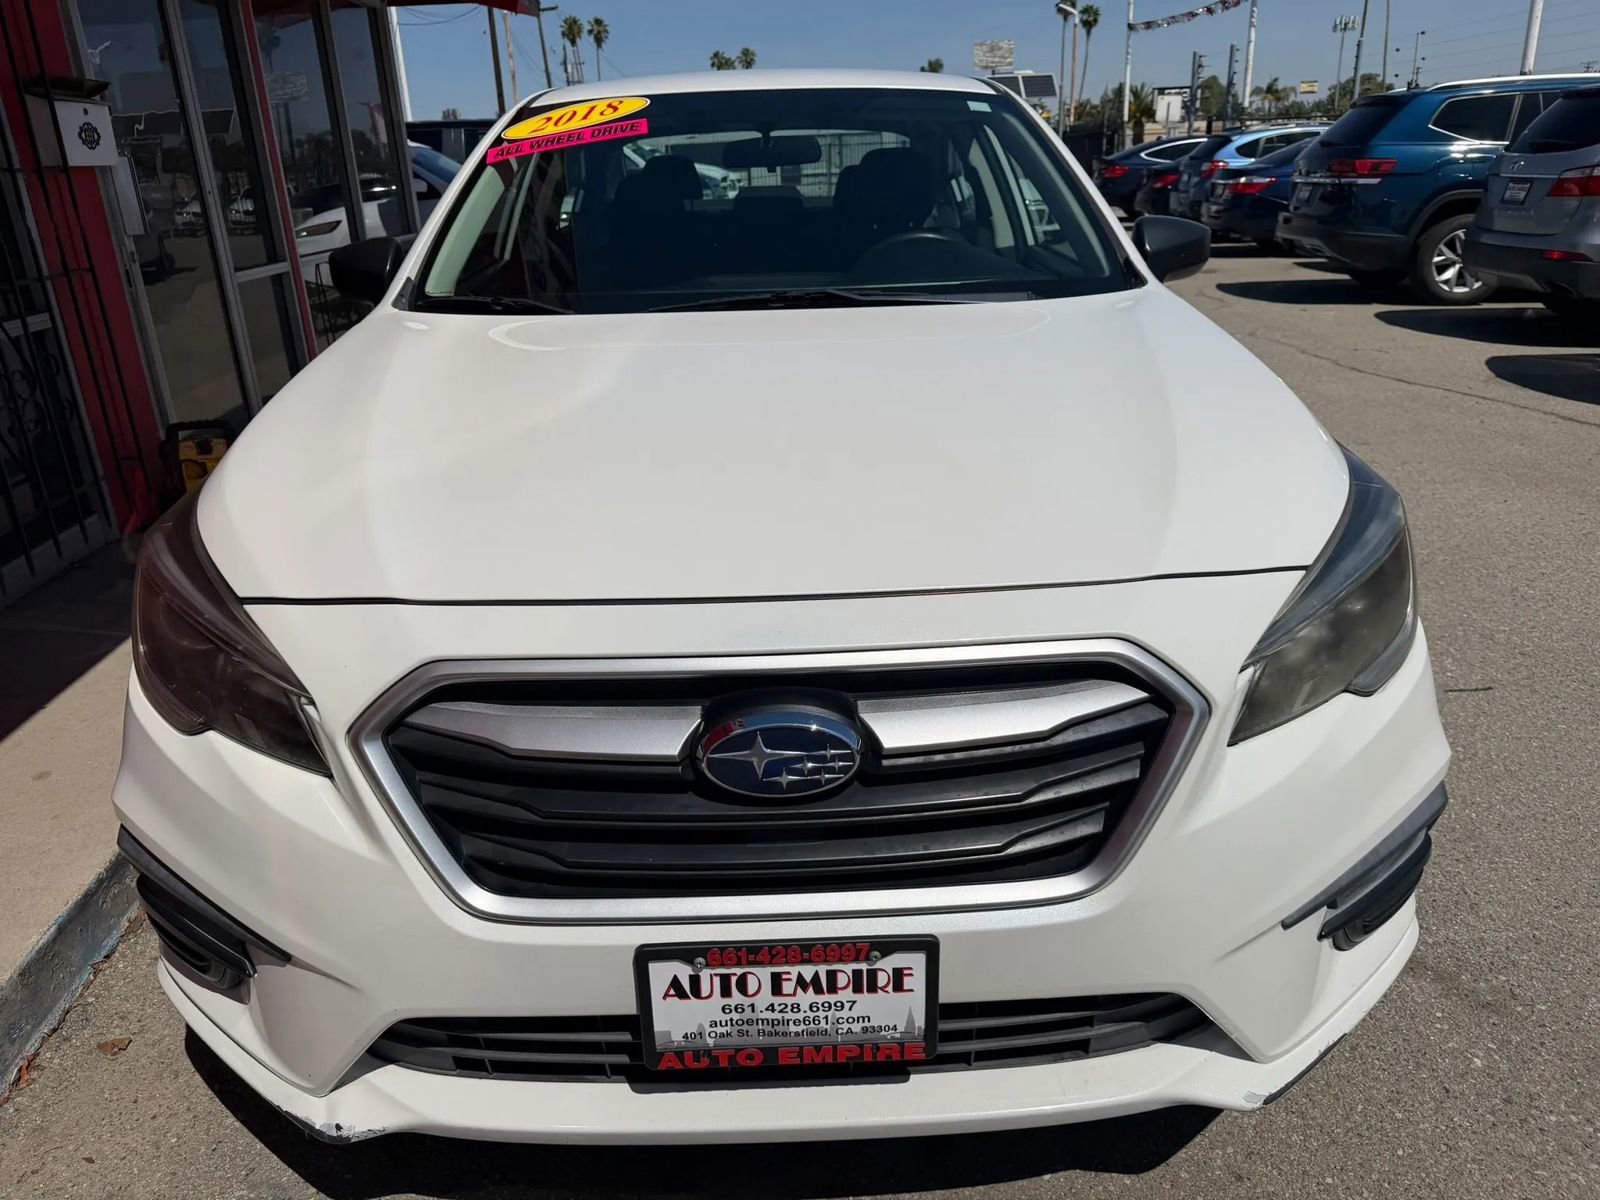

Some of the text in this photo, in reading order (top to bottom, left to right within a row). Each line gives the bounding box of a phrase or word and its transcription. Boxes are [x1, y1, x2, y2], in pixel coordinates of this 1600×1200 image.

[528, 100, 625, 135] 2018
[494, 122, 642, 158] ALL WHEEL DRIVE
[706, 943, 871, 967] 661-428-6997
[662, 967, 916, 1001] AUTO EMPIRE
[721, 1000, 858, 1015] 661.428.6997
[681, 1030, 703, 1040] 401
[708, 1029, 733, 1039] Oak
[736, 1028, 753, 1038] St.
[758, 1027, 832, 1038] Bakersfield,
[861, 1024, 898, 1034] 93304
[708, 1015, 871, 1029] autoempire661.com
[657, 1043, 926, 1070] AUTO EMPIRE
